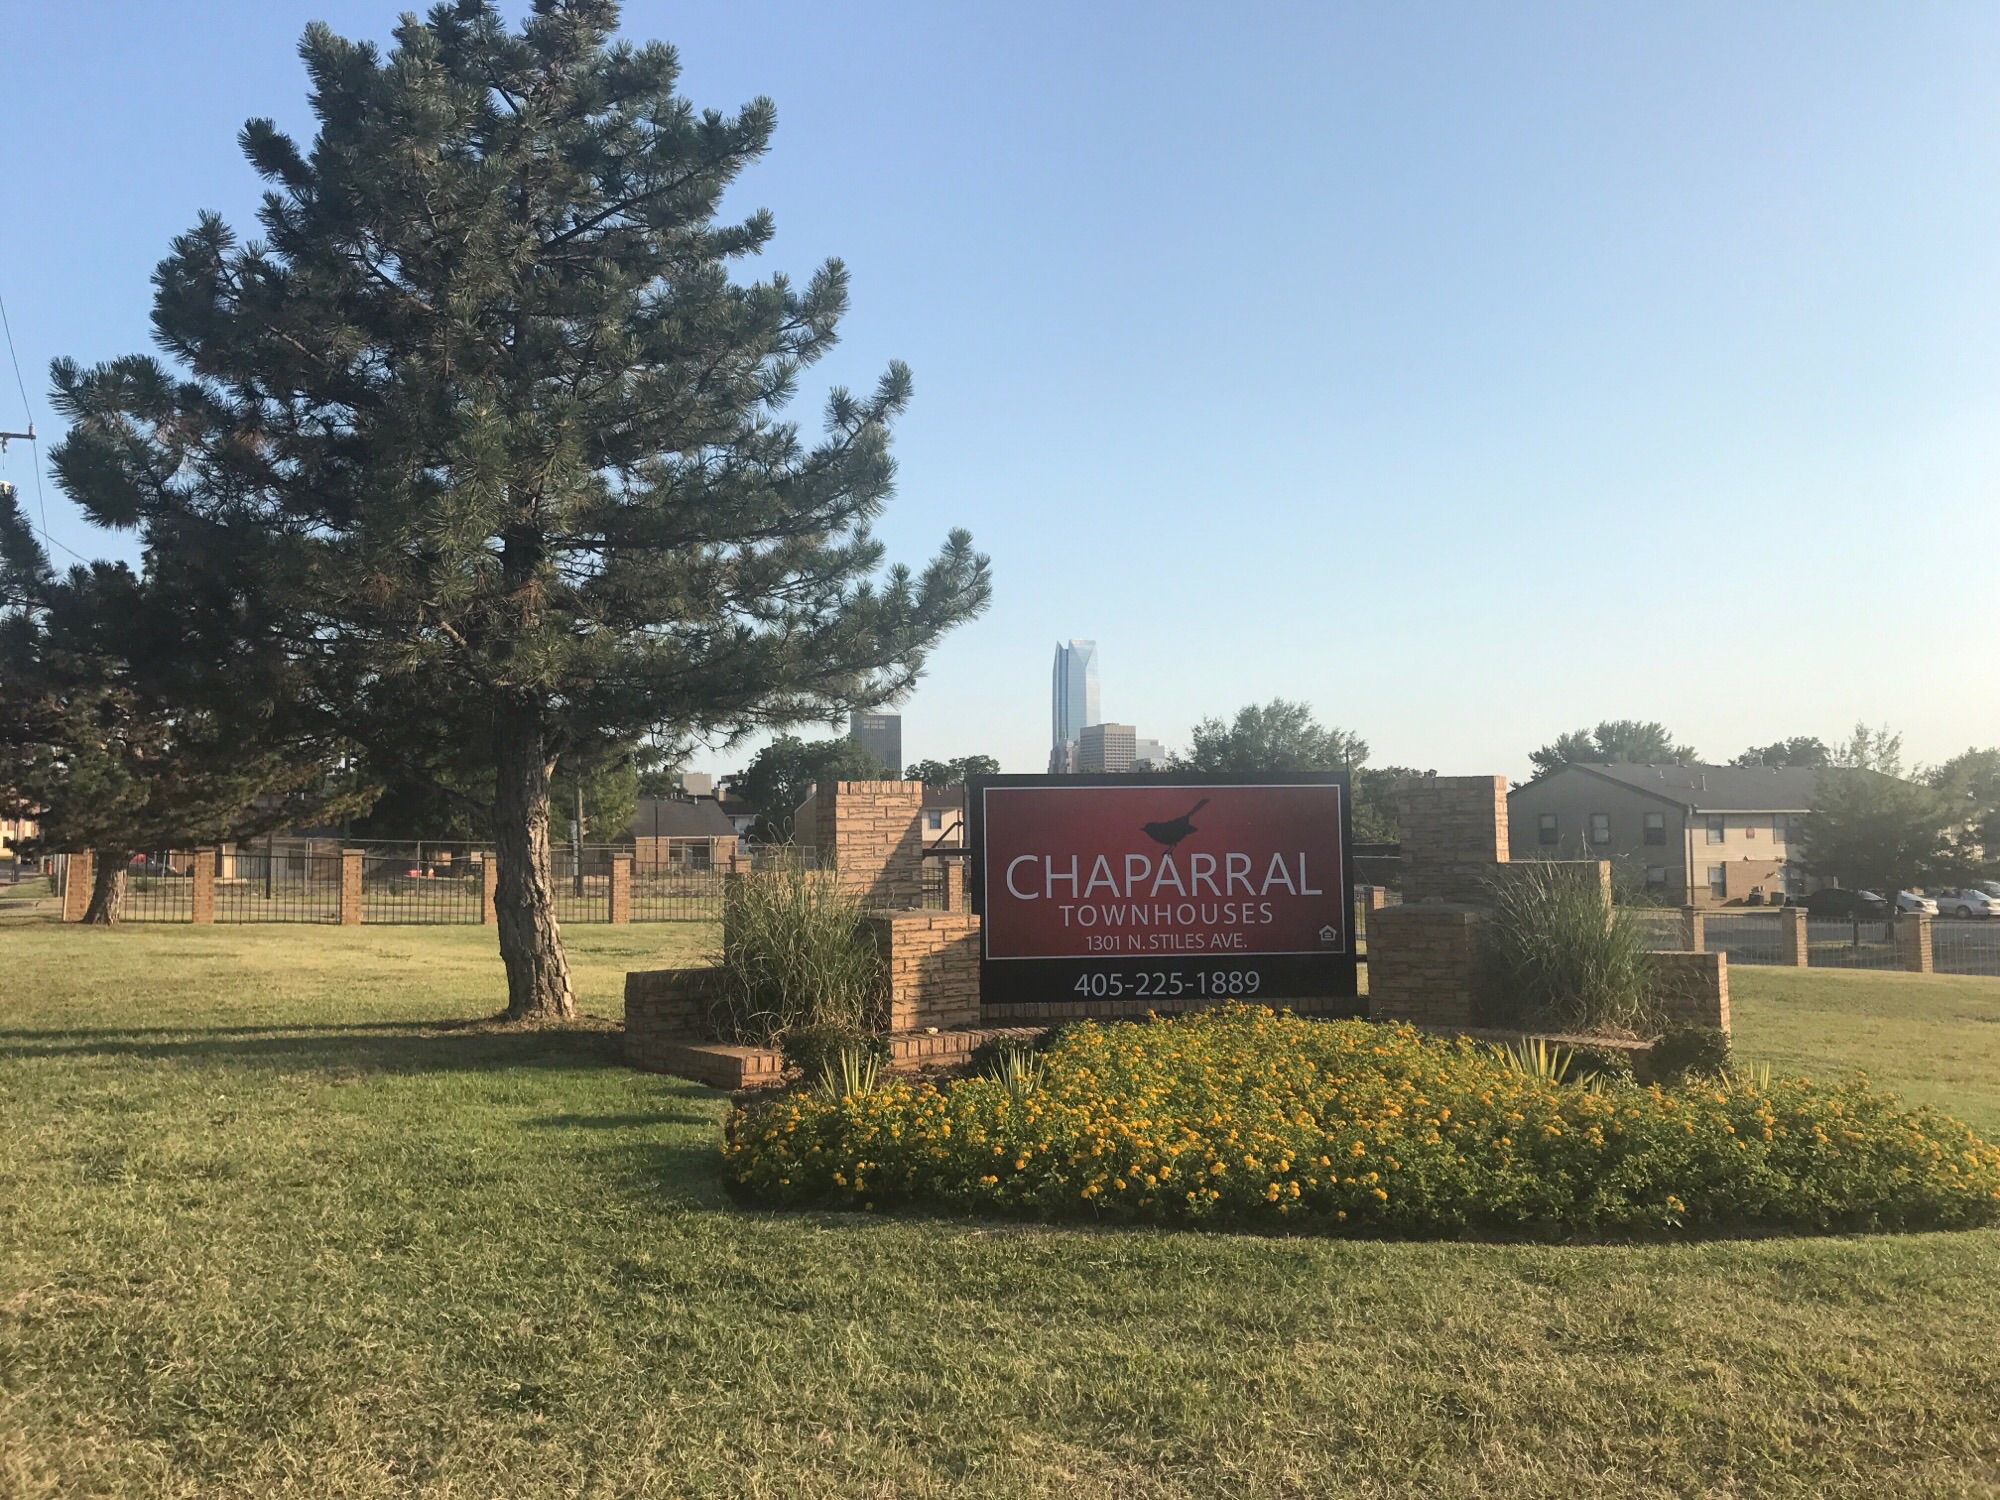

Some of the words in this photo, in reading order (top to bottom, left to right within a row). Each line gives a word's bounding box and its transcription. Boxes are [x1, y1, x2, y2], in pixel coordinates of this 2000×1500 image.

[1006, 852, 1323, 900] CHAPARRAL
[1058, 902, 1274, 927] TOWNHOUSES
[1086, 934, 1120, 951] 1301
[1128, 934, 1146, 950] N.
[1149, 933, 1205, 950] STILES
[1210, 932, 1248, 950] AVE.
[1074, 970, 1260, 997] 405-225-1889
